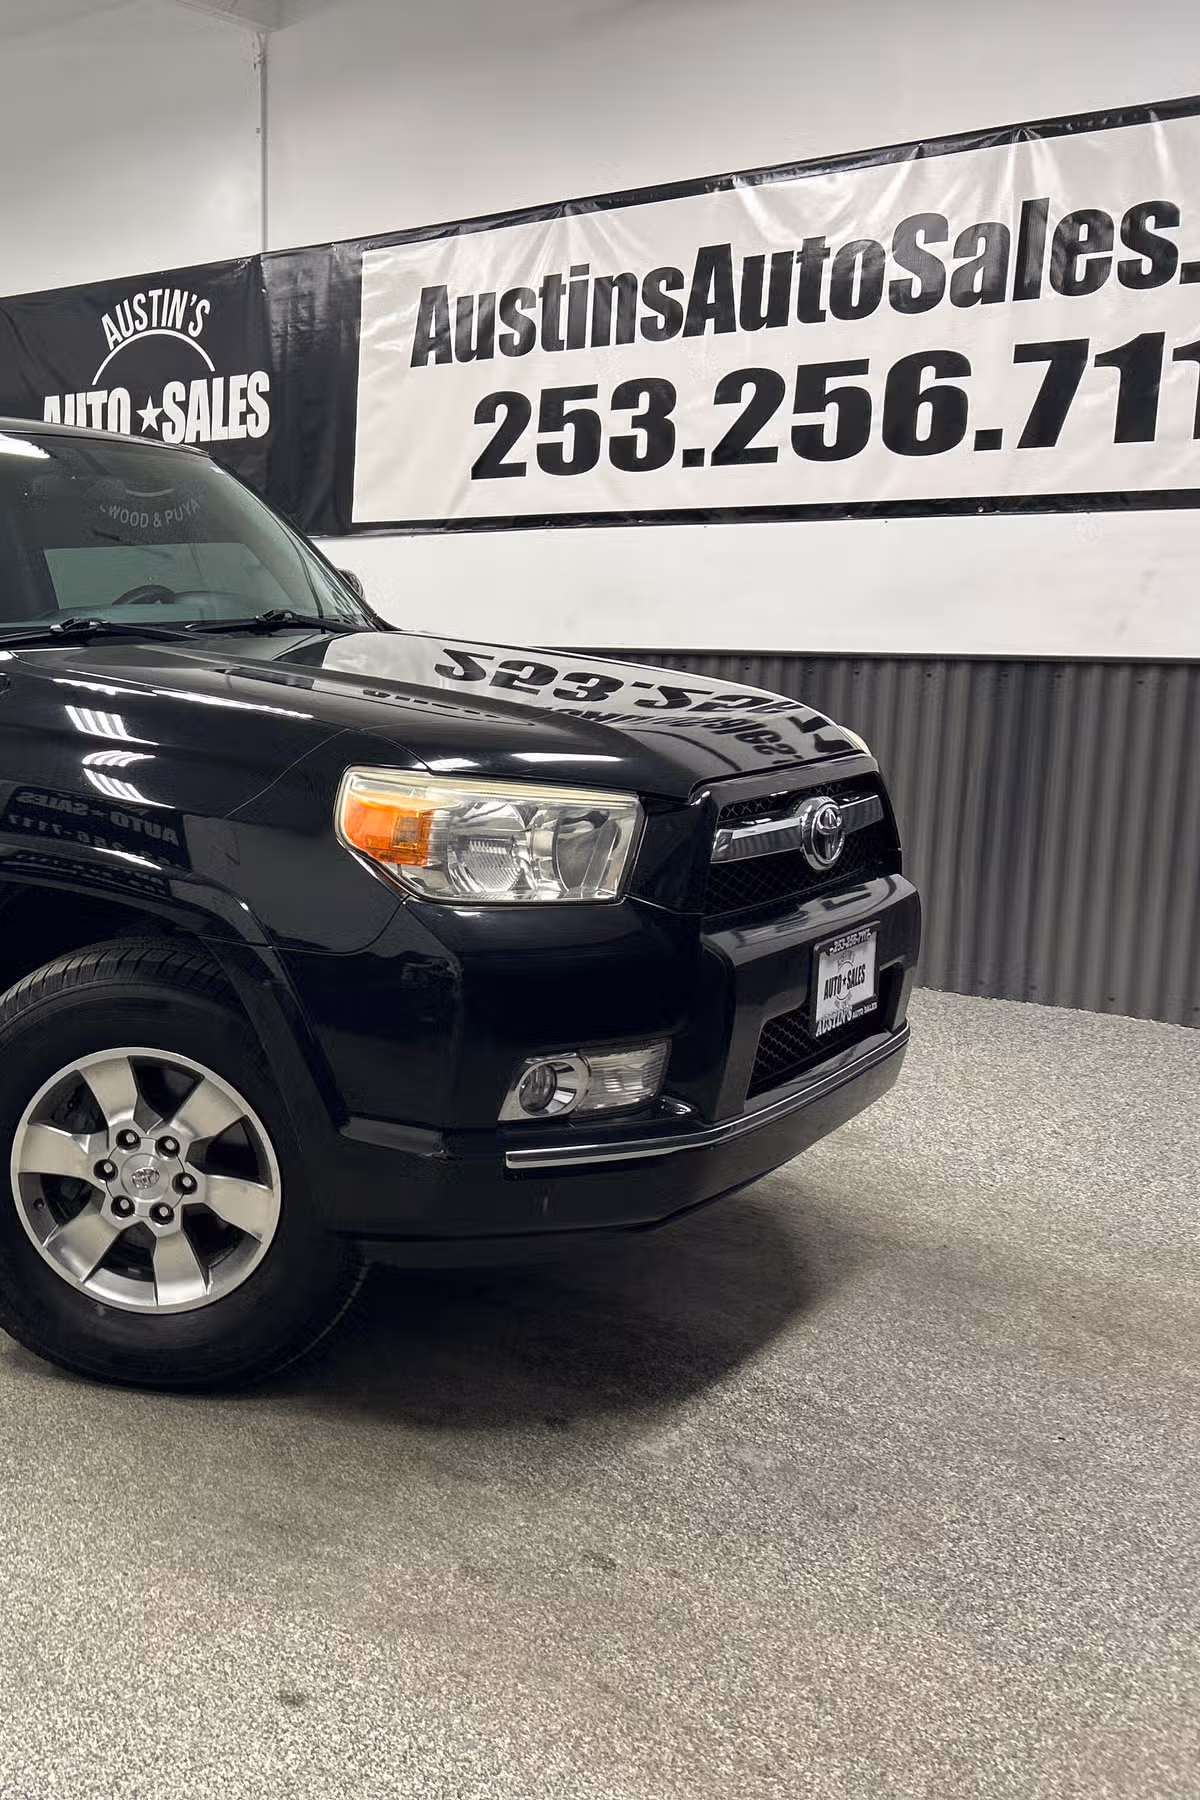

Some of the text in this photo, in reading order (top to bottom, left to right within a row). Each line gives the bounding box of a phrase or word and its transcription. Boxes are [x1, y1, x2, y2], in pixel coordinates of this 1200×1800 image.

[101, 288, 211, 351] AUSTIN'S
[162, 371, 270, 444] SALES
[823, 974, 842, 1001] AUTO
[847, 963, 866, 990] SALES
